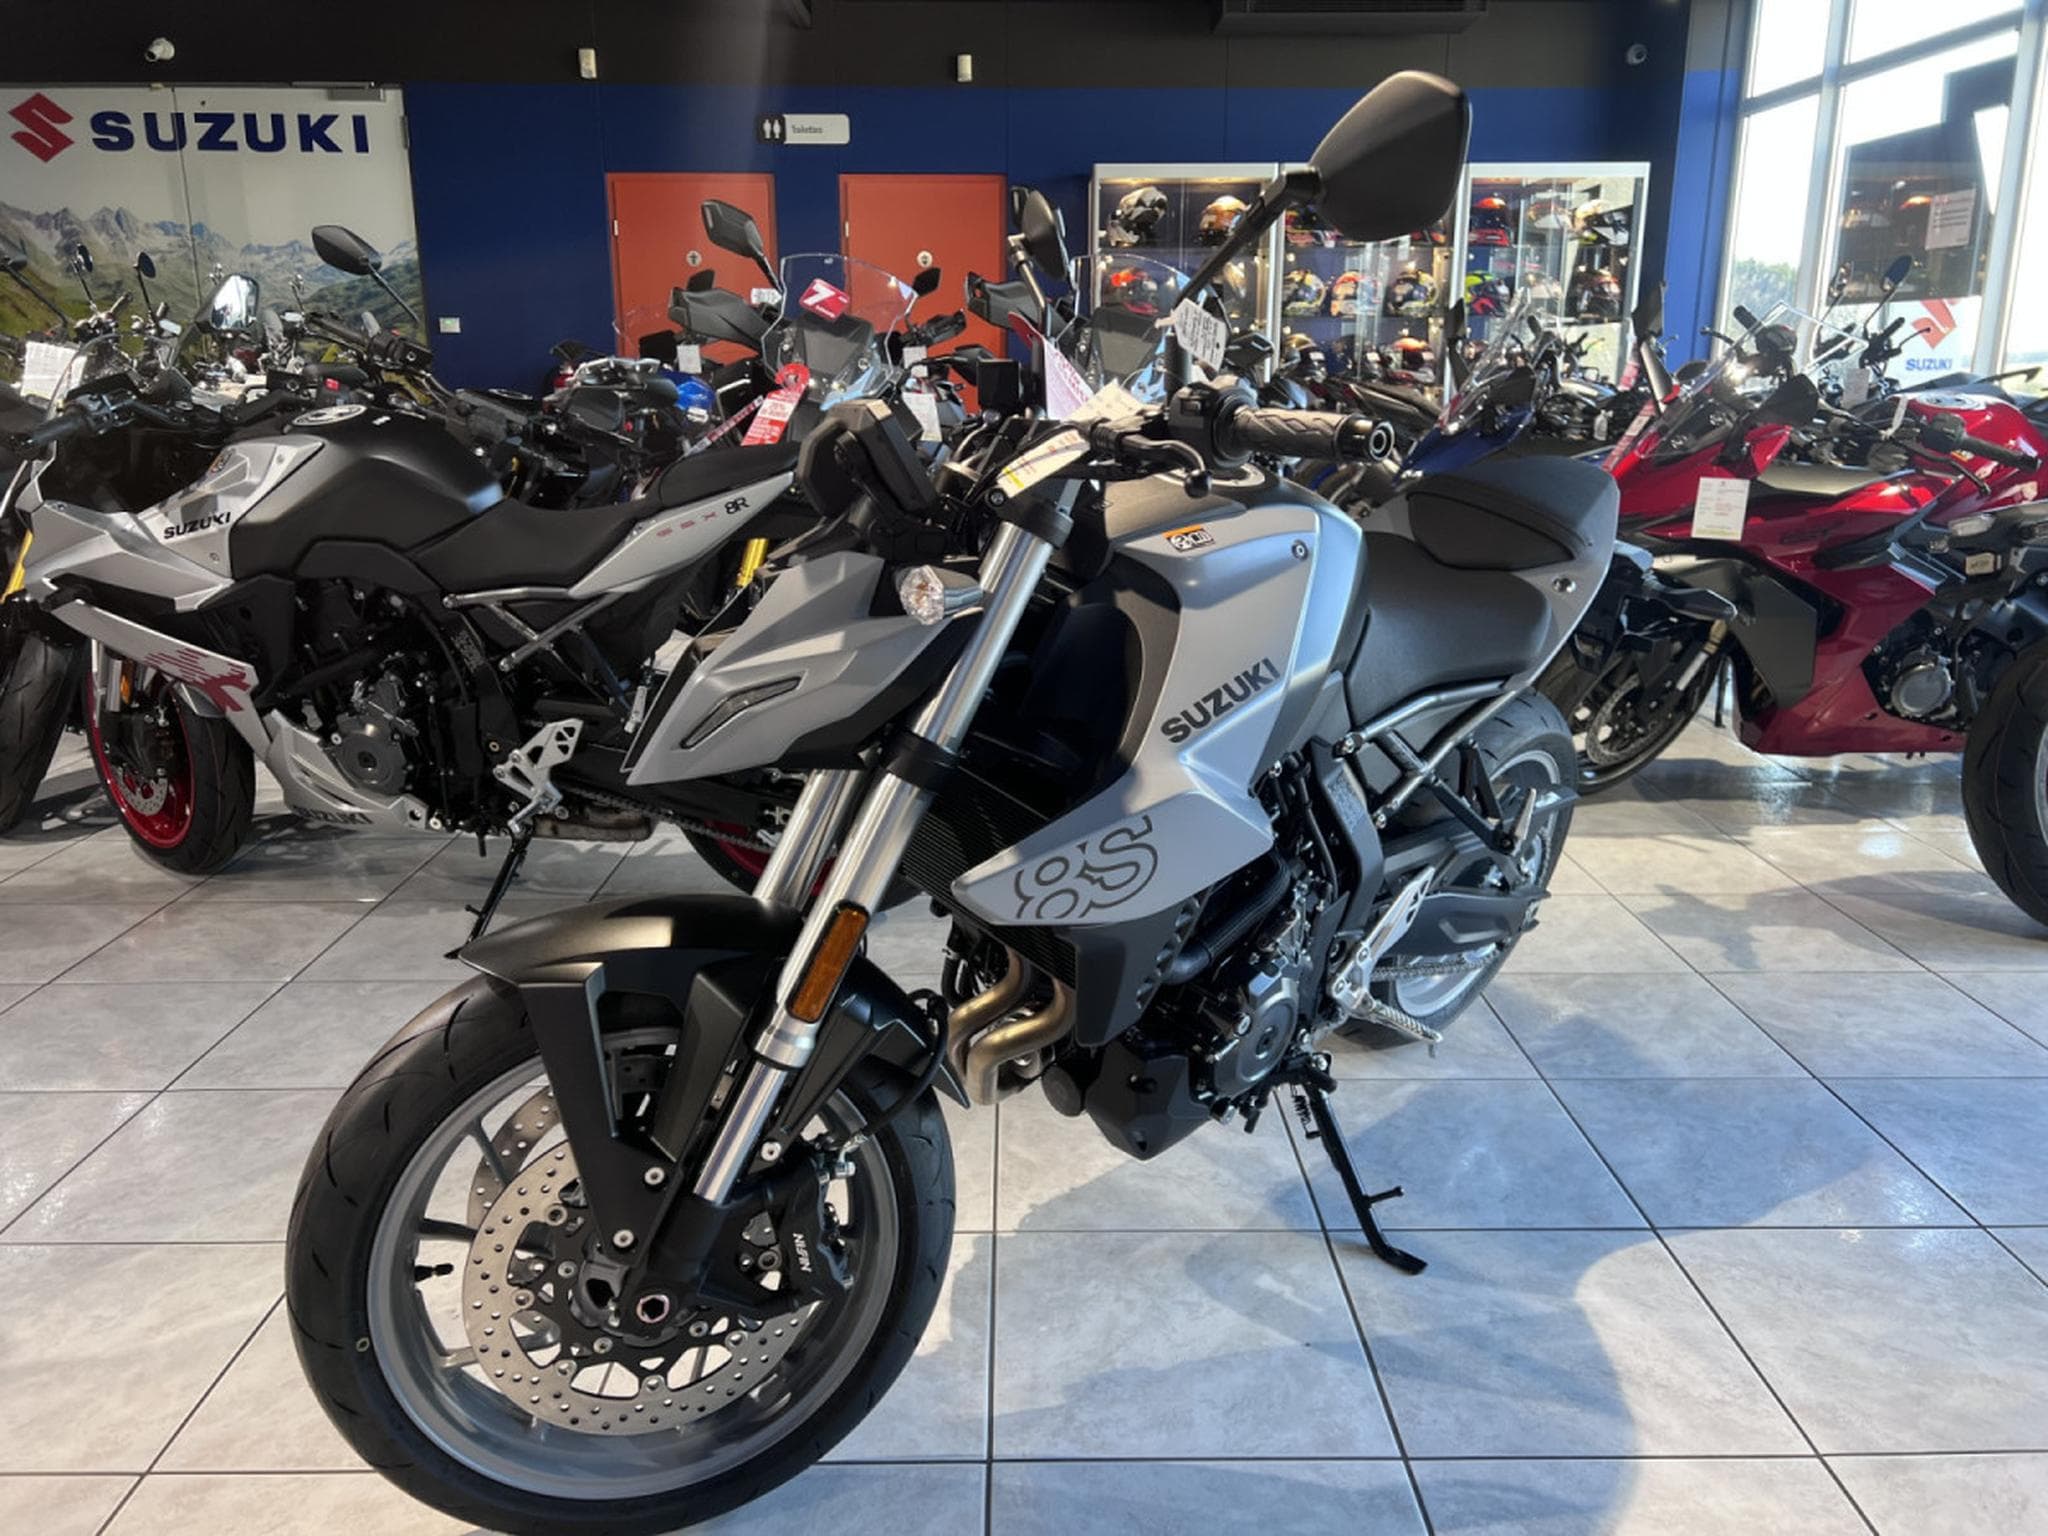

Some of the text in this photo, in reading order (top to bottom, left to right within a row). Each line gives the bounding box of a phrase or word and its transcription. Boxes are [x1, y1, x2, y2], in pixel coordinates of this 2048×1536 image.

[91, 111, 370, 153] SUZUKI
[1905, 357, 1952, 371] SUZUKI
[724, 497, 751, 515] 8R
[163, 512, 231, 539] SUZUKI
[1160, 657, 1281, 743] SUZUKI
